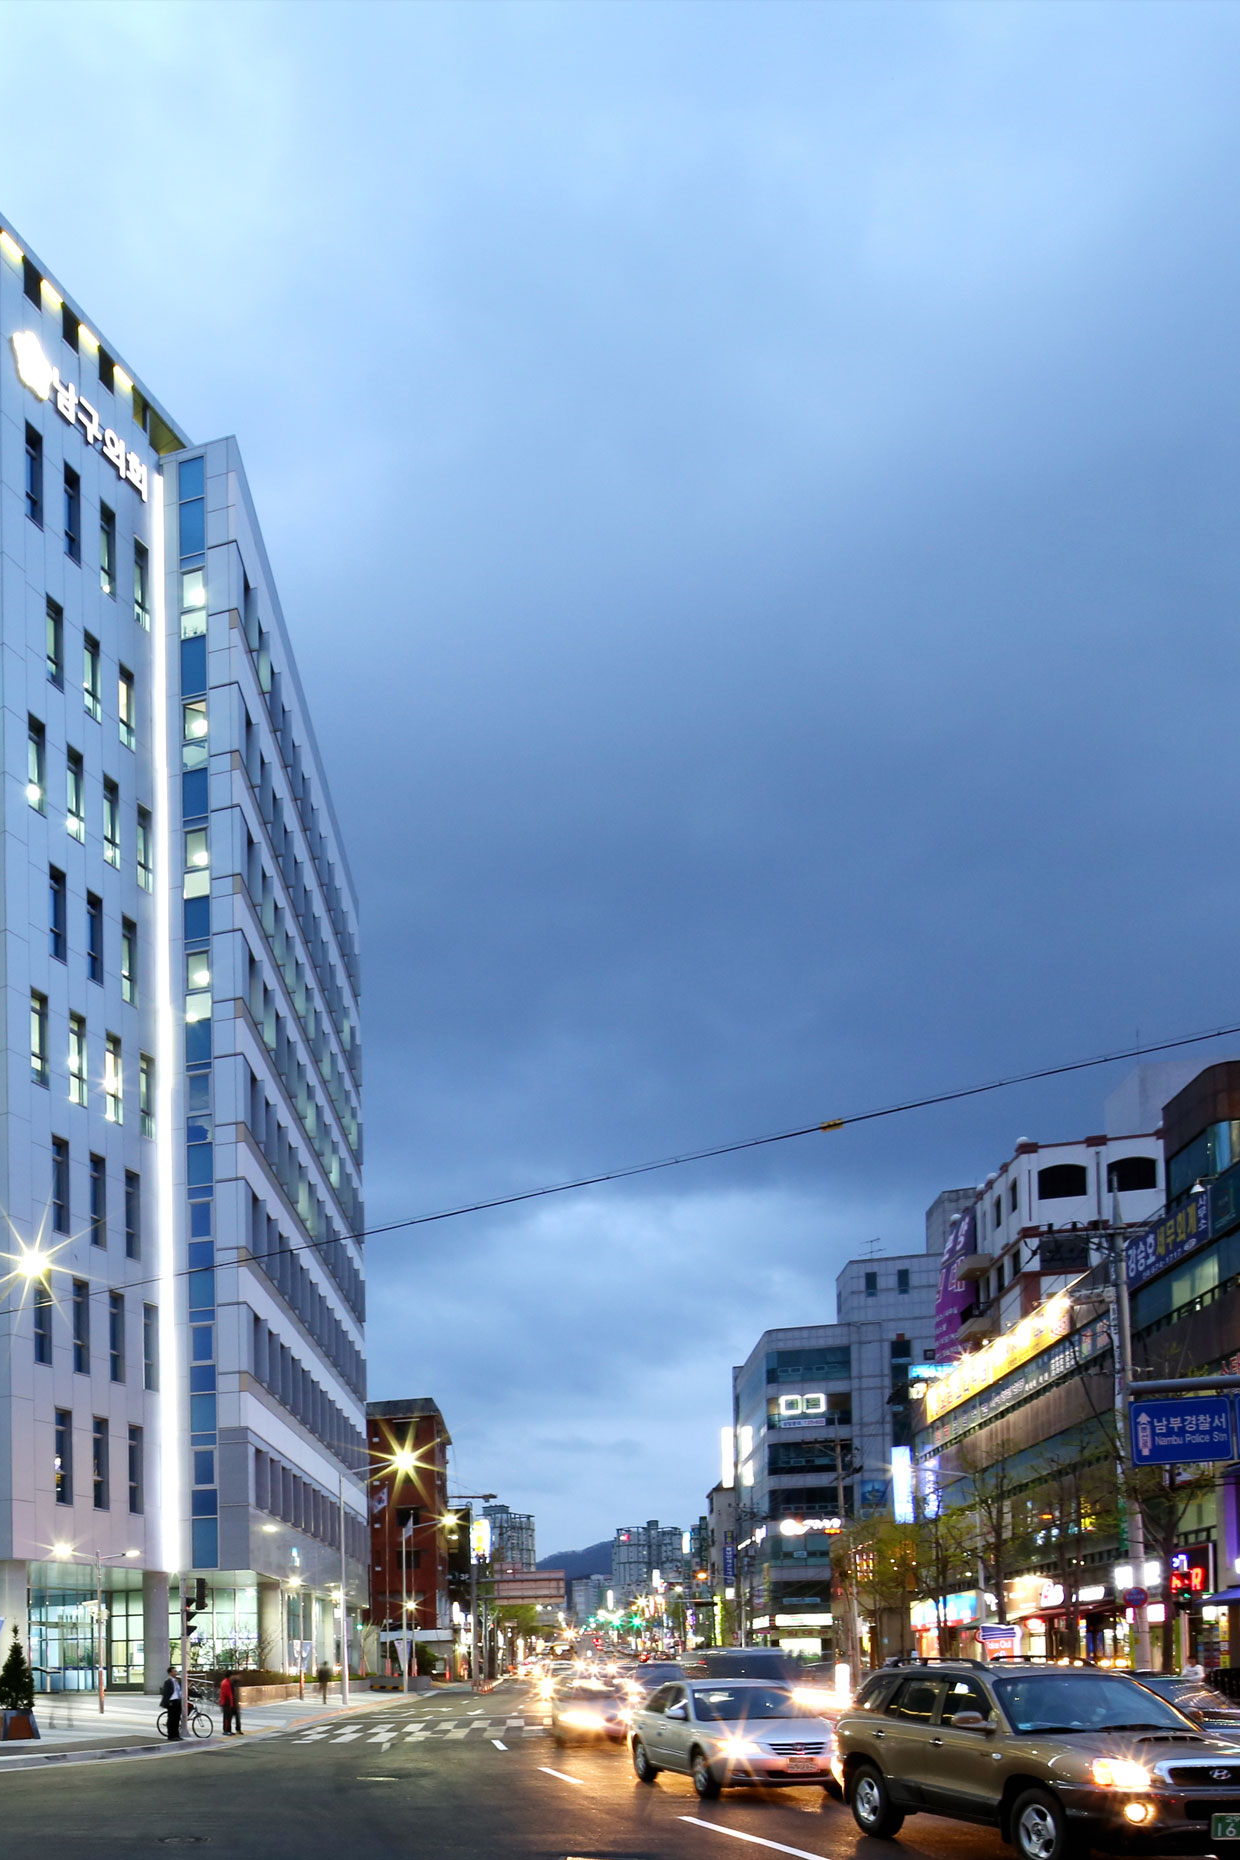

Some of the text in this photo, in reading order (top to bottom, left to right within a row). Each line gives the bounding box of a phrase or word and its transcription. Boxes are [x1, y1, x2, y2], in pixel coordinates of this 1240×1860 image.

[52, 366, 148, 503] 남구의회
[1153, 1413, 1227, 1434] 남부경찰서
[1155, 1435, 1183, 1446] Nambu
[1185, 1433, 1210, 1444] Police
[1213, 1431, 1228, 1442] Stn
